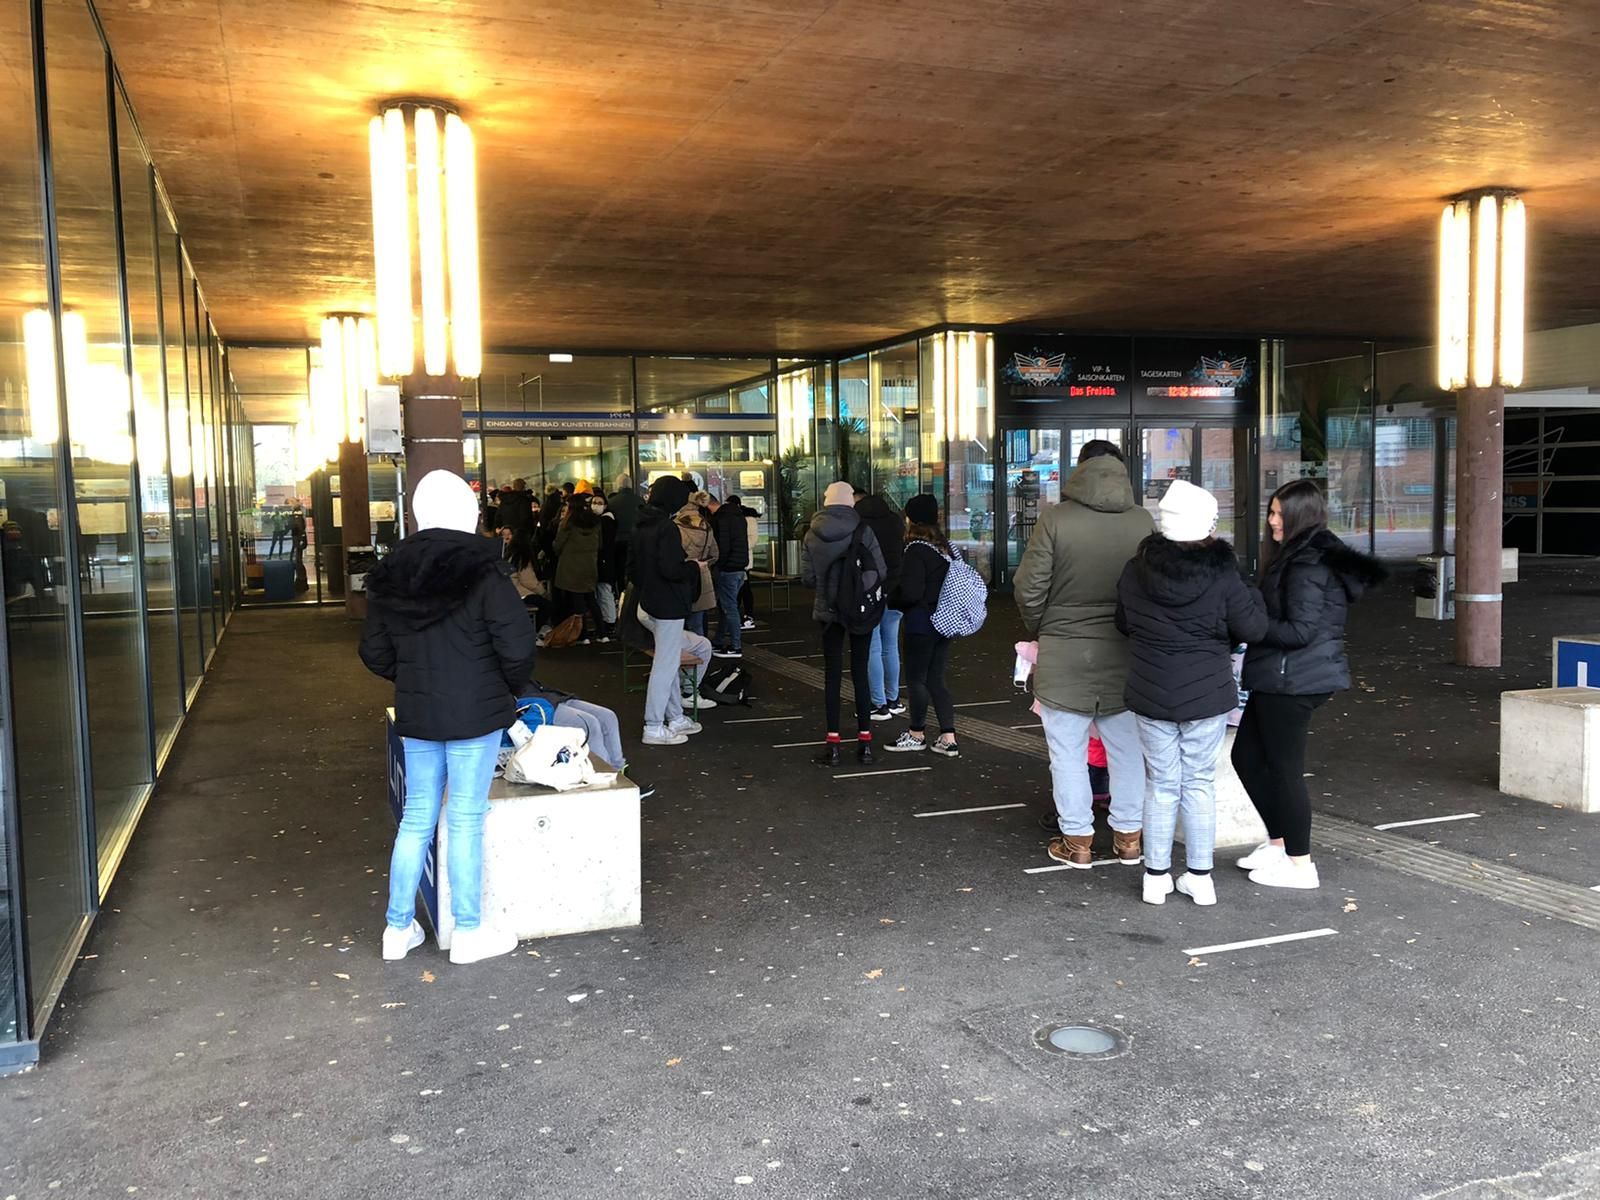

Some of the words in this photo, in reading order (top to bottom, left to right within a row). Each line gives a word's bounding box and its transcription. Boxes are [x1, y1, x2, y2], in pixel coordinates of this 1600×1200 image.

[1077, 373, 1125, 381] SAISONKARTEN
[1140, 370, 1182, 378] TAGESKARTEN
[1070, 386, 1084, 396] Das
